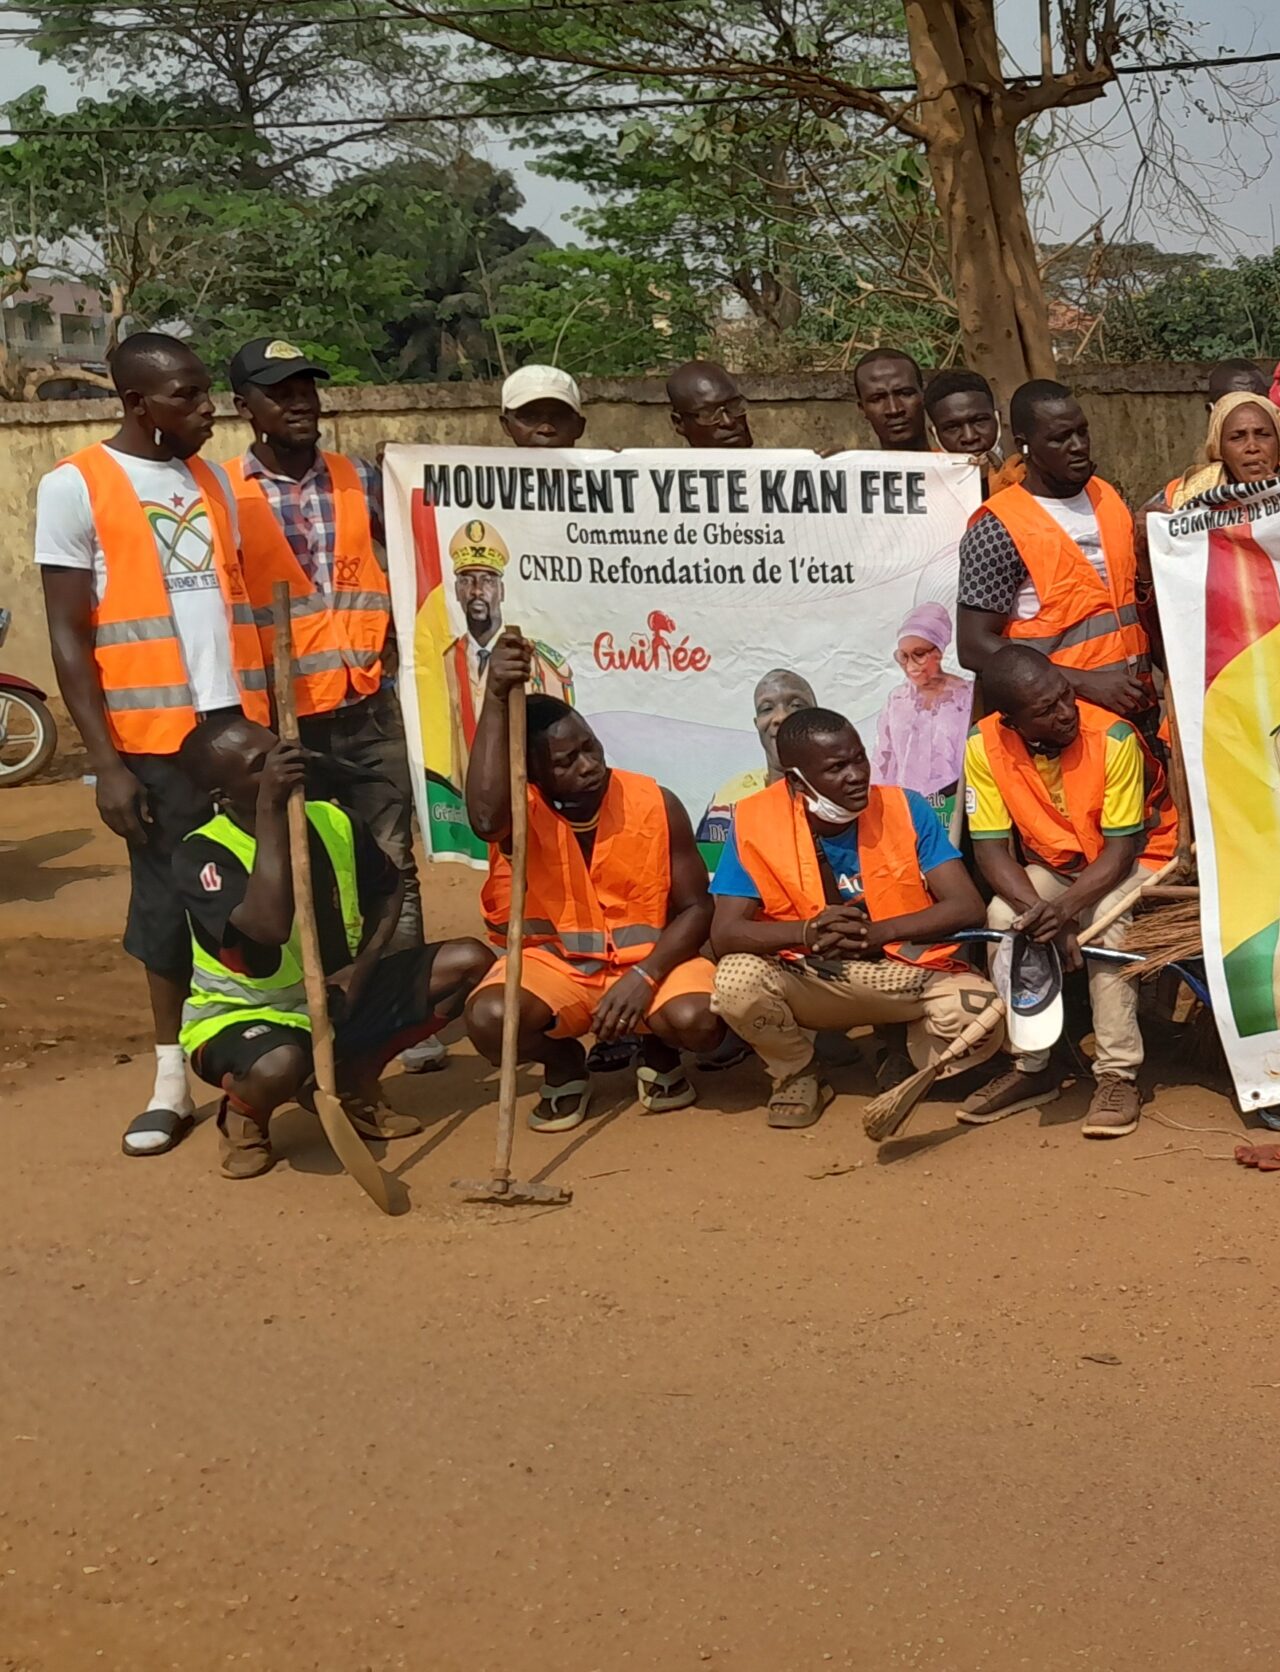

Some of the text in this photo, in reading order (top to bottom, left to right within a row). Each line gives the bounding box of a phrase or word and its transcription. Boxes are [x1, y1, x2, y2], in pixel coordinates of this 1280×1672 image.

[422, 464, 928, 515] MOUVEMENT YETE KAN FEE
[566, 522, 785, 546] Commune de Gbéssia
[1168, 507, 1244, 537] COMMUNE
[1246, 504, 1262, 523] DE
[519, 554, 855, 585] CNRD Refondation de l'état
[592, 615, 712, 672] Guinée
